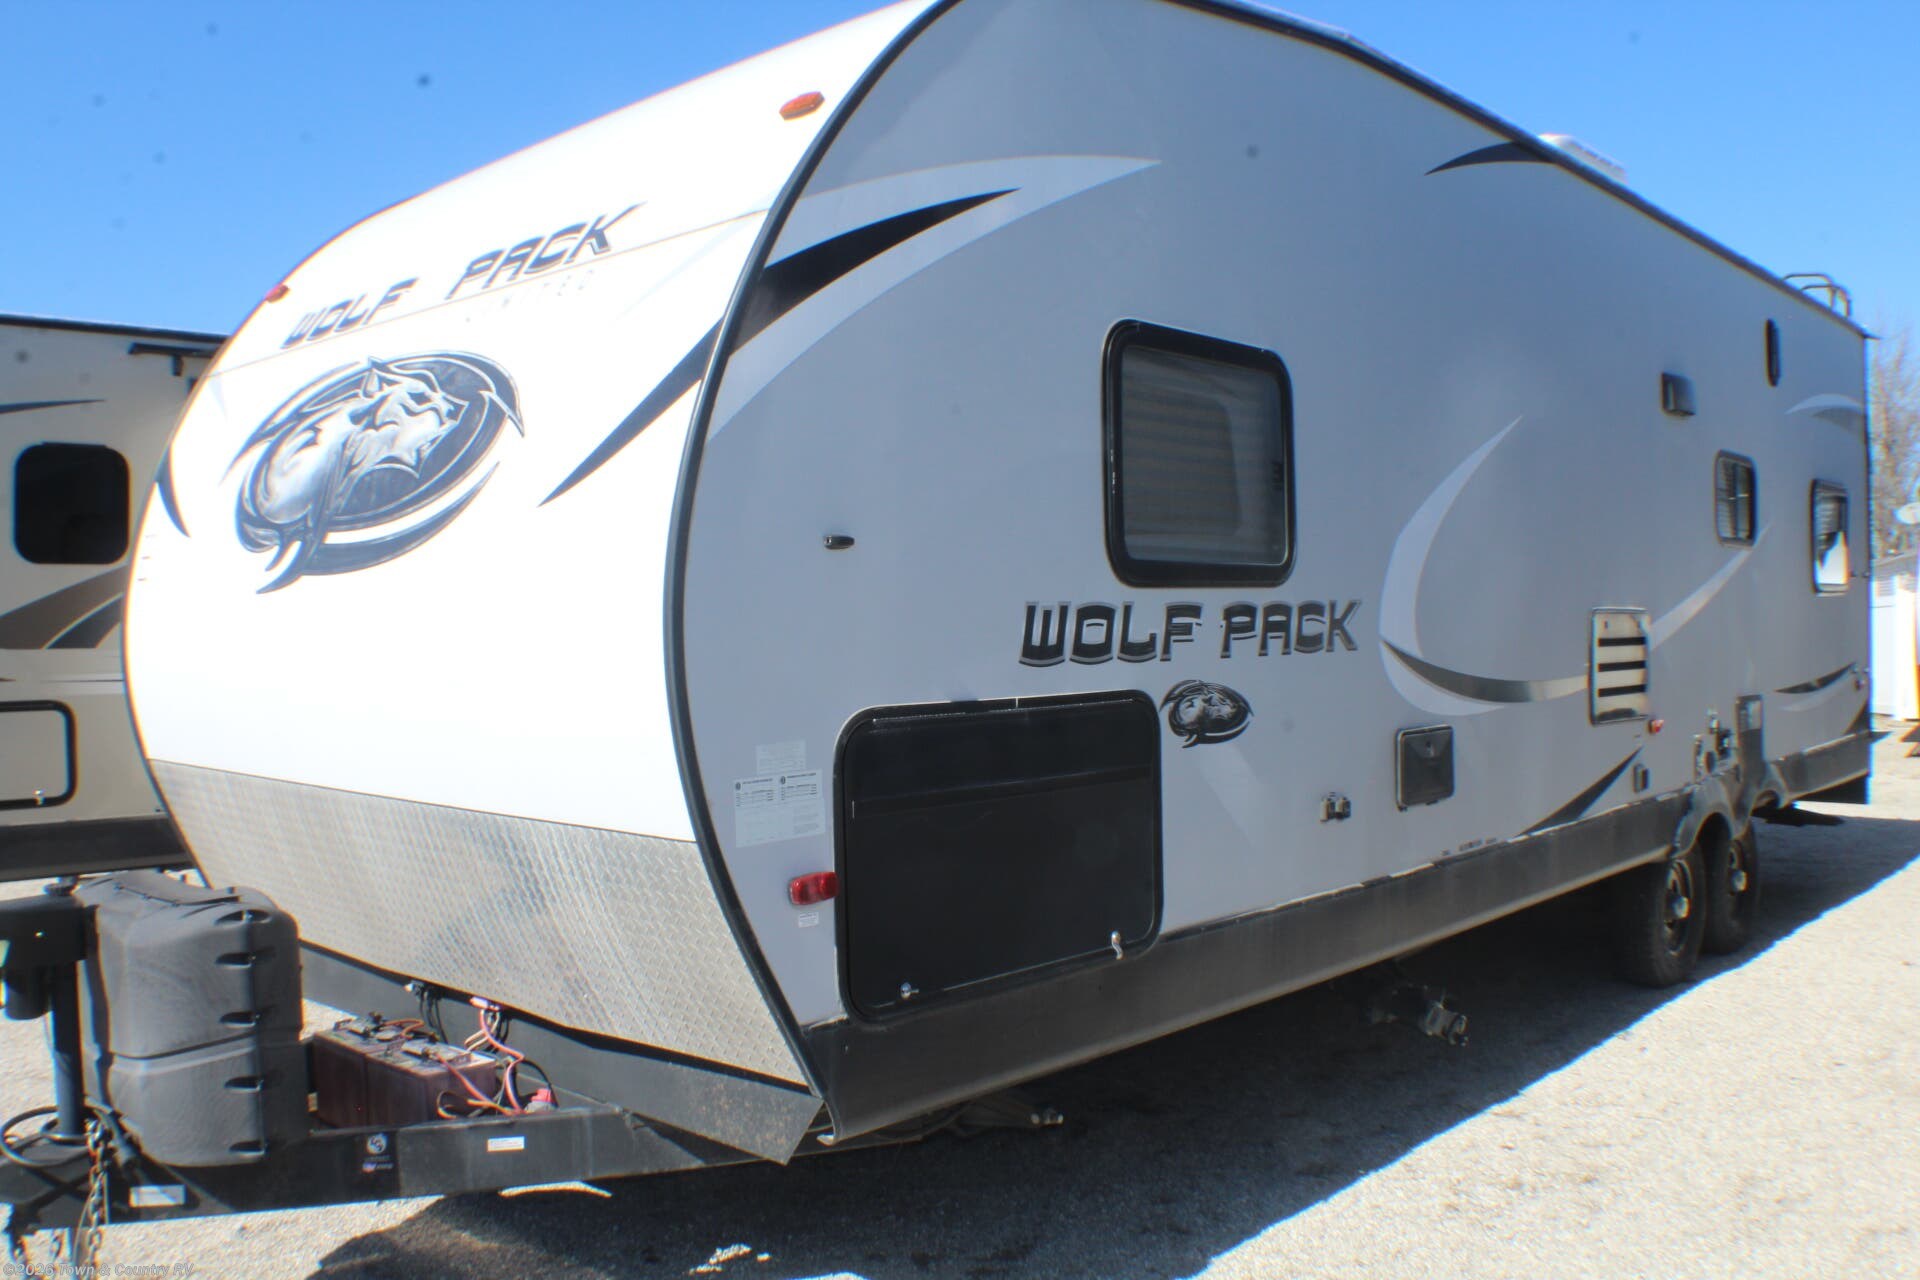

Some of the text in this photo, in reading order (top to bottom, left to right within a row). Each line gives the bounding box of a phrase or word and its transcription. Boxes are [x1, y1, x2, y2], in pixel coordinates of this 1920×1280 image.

[280, 277, 419, 350] WOLF
[444, 201, 647, 300] PACK
[1019, 599, 1362, 667] WOLF PACK
